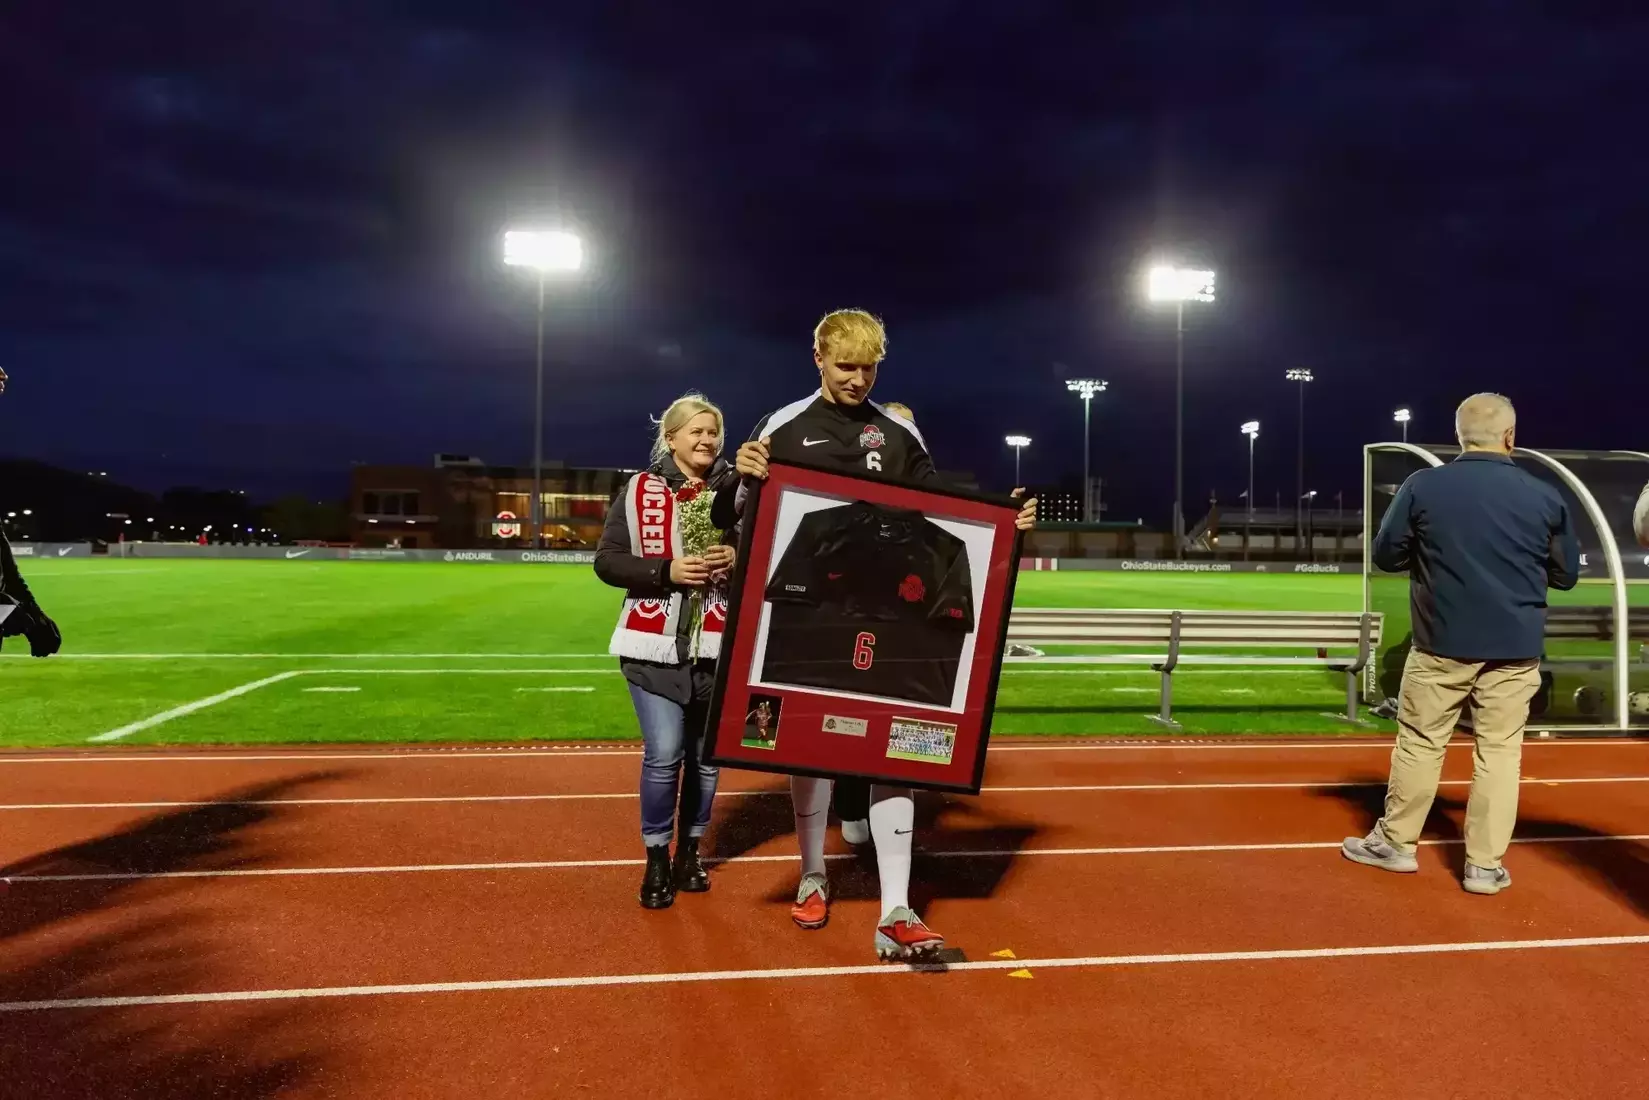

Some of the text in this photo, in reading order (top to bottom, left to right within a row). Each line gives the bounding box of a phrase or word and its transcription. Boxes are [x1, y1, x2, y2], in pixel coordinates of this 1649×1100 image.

[866, 451, 882, 471] 6
[455, 552, 494, 560] ANDURIL
[1121, 561, 1231, 573] OhioStateBuckeyes.com
[1294, 563, 1339, 573] #GoBucks
[852, 631, 875, 670] 6
